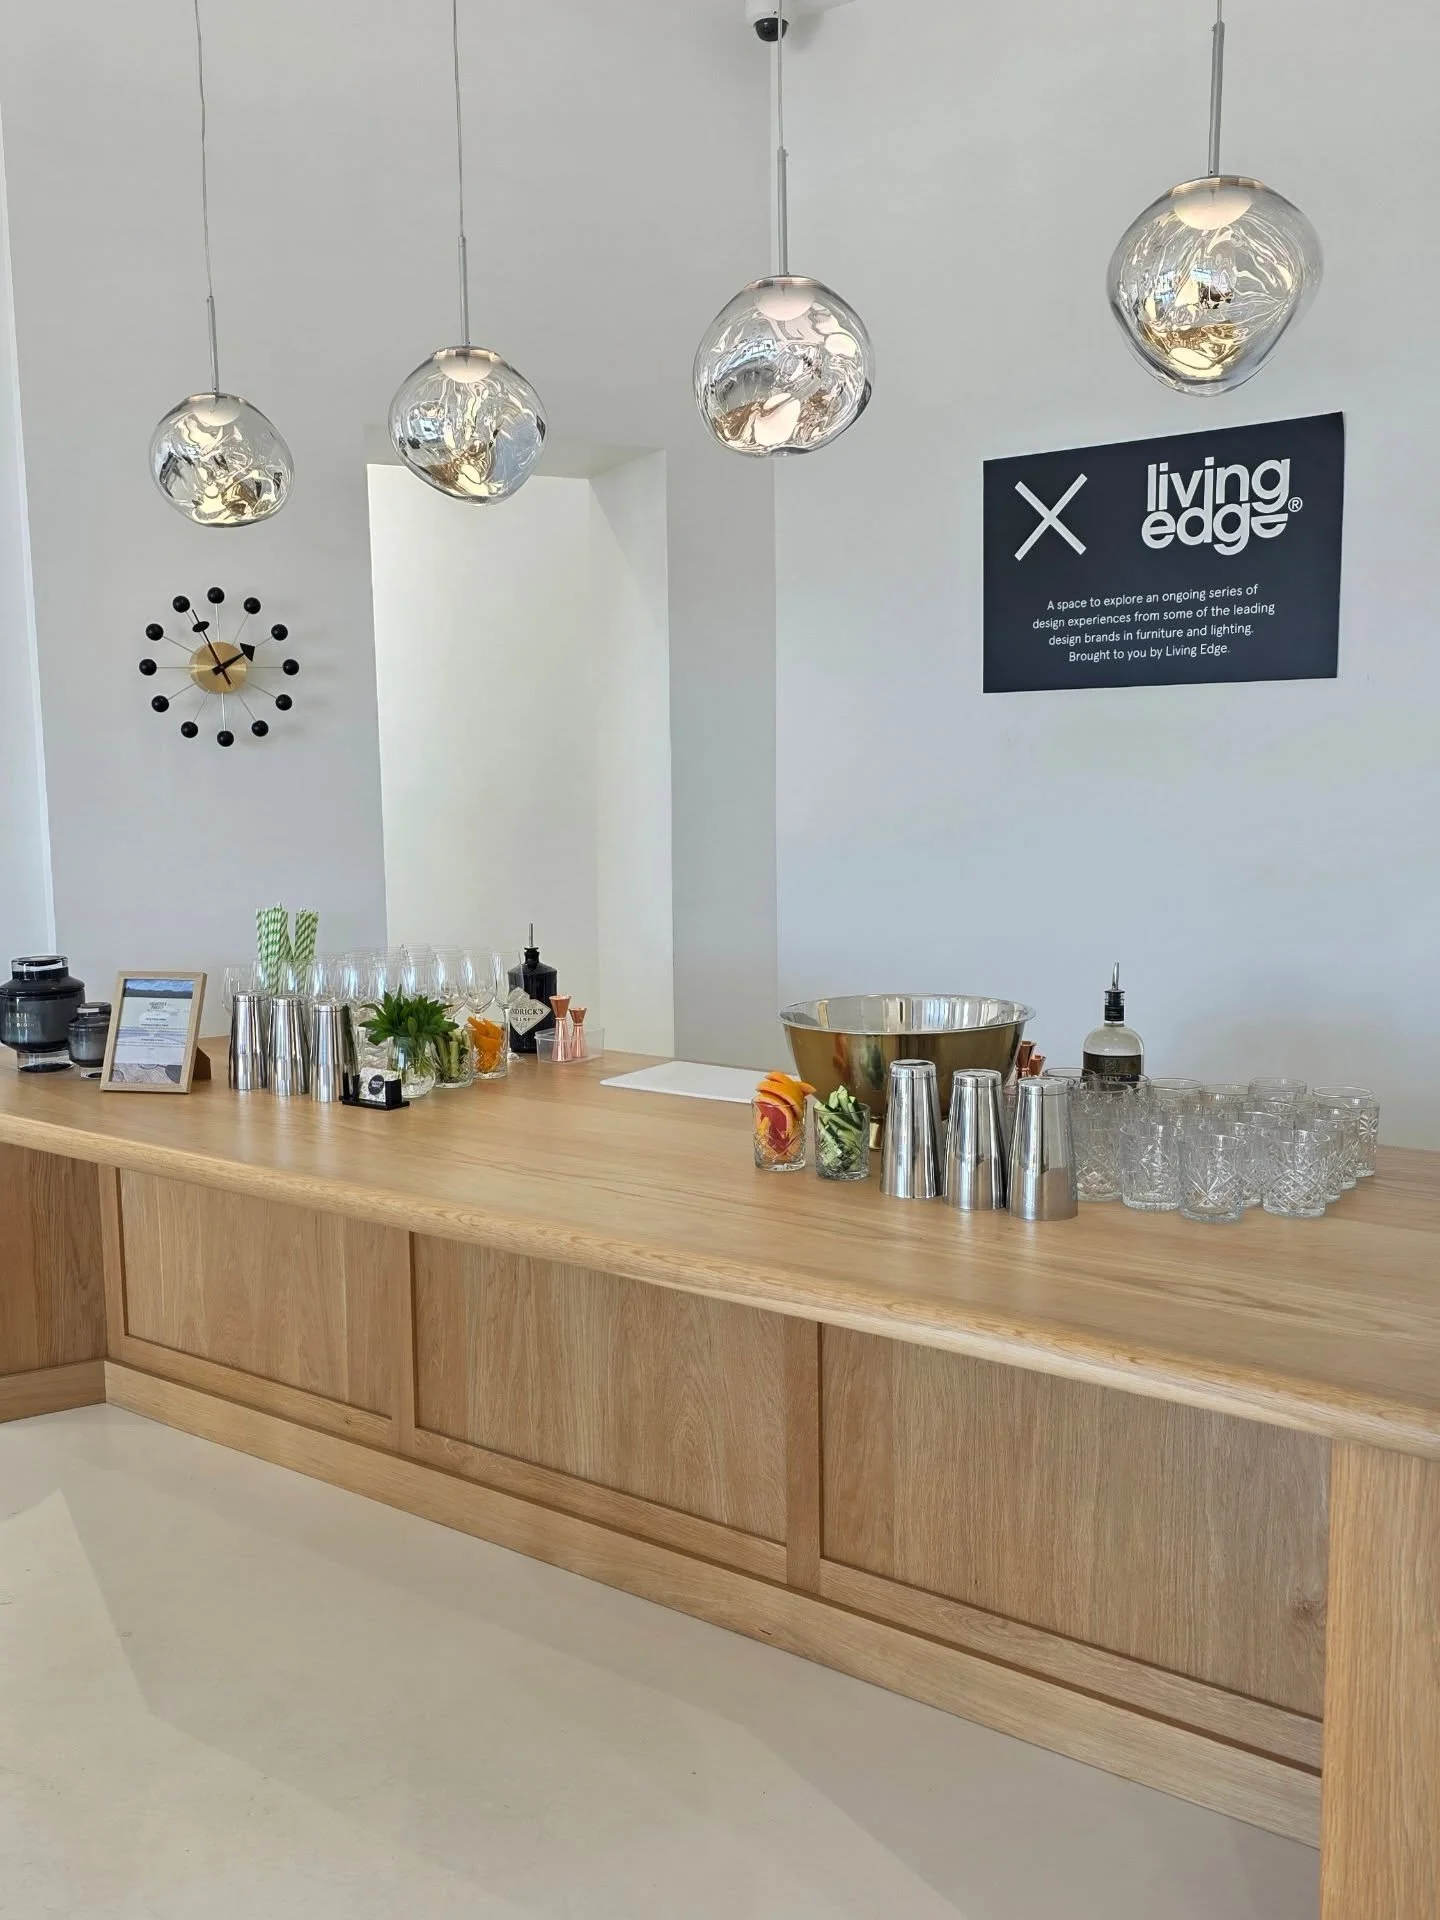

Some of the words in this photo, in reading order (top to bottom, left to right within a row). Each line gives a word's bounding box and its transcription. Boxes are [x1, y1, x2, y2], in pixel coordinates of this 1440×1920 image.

[1147, 456, 1291, 514] living
[1141, 502, 1288, 556] edge
[1047, 600, 1055, 610] A
[1057, 599, 1087, 612] space
[1090, 596, 1101, 608] to
[1103, 594, 1143, 608] explore
[1146, 593, 1159, 603] an
[1162, 588, 1206, 604] ongoing
[1208, 586, 1242, 598] series
[1245, 583, 1258, 595] of
[1032, 618, 1065, 630] design
[1067, 614, 1131, 628] experiences
[1134, 611, 1160, 622] from
[1163, 609, 1193, 620] some
[1195, 606, 1208, 618] of
[1211, 605, 1230, 617] the
[1233, 602, 1275, 616] leading
[1048, 634, 1081, 647] design
[1084, 630, 1120, 644] brands
[1123, 630, 1133, 641] in
[1136, 628, 1184, 640] furniture
[1186, 624, 1208, 637] and
[1210, 623, 1254, 638] lighting.
[1069, 650, 1111, 663] Brought
[1112, 649, 1125, 660] to
[1127, 649, 1147, 661] you
[1150, 646, 1163, 660] by
[1165, 644, 1197, 658] Living
[1200, 643, 1230, 657] Edge.
[509, 1007, 544, 1016] NDRICK'S
